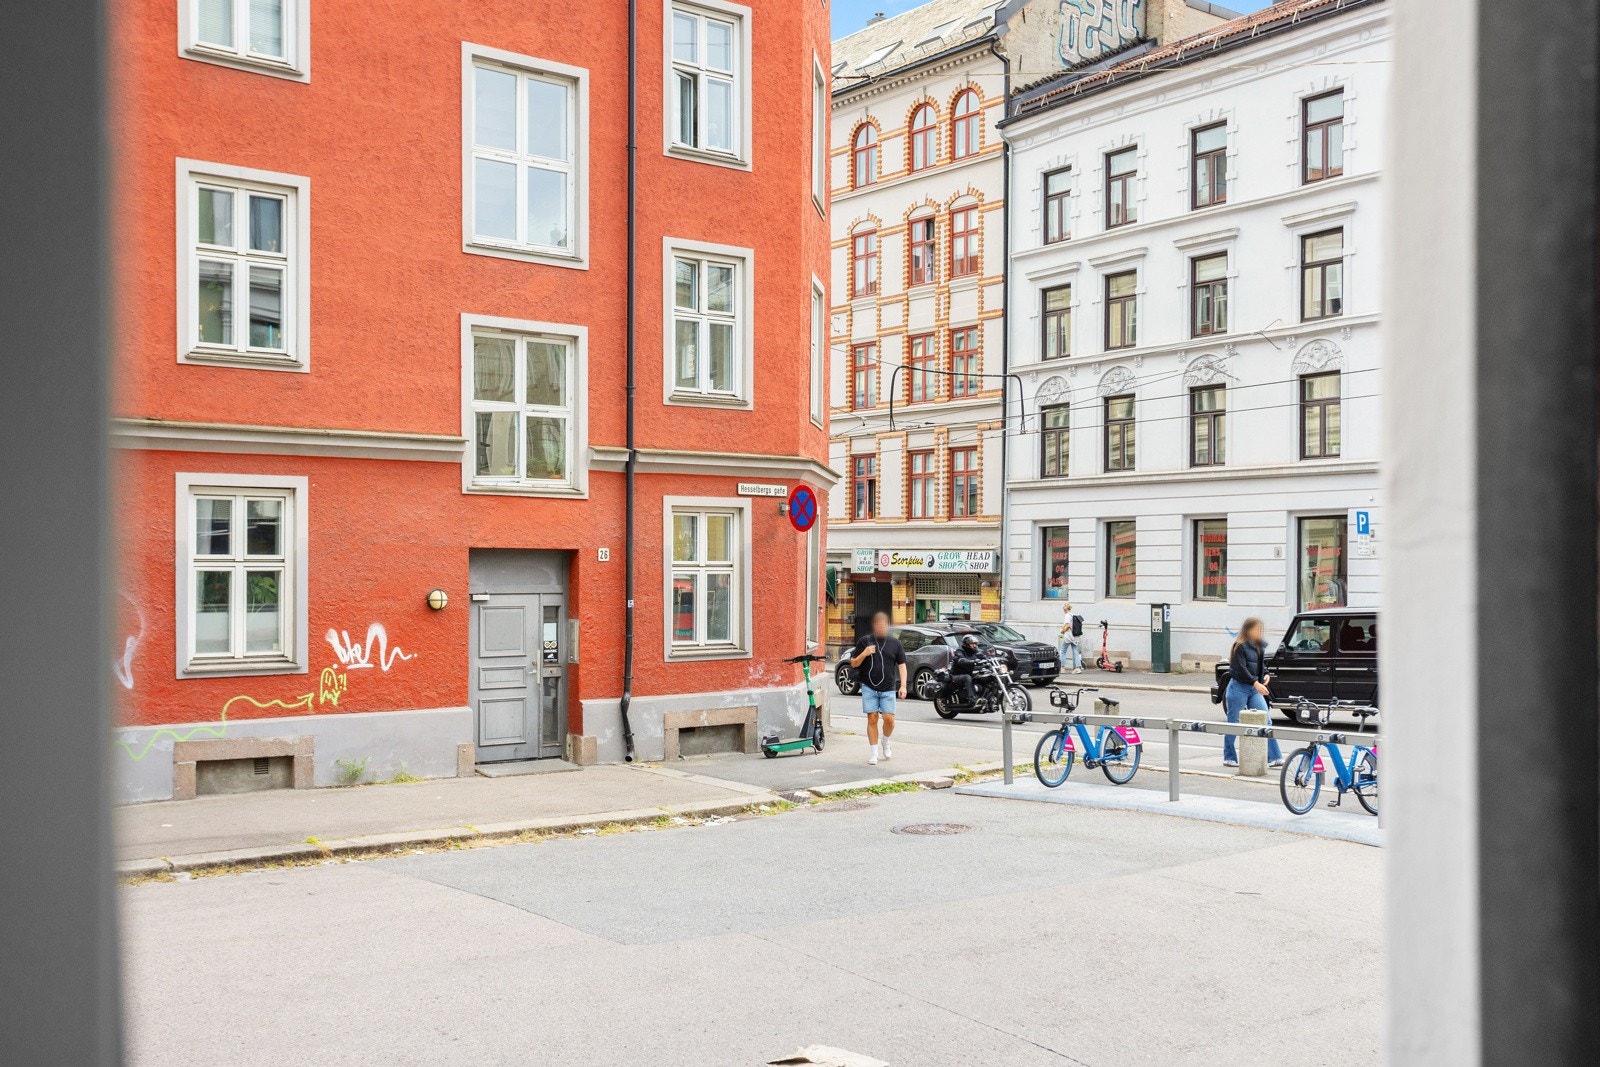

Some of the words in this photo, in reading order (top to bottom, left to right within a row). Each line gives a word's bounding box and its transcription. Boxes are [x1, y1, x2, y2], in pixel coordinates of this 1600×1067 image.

[740, 484, 771, 495] Hesselbergs
[774, 487, 786, 496] gate
[1359, 514, 1366, 531] P
[599, 550, 608, 560] 26
[891, 552, 925, 568] Scorpius
[937, 551, 961, 560] GROW
[966, 552, 990, 560] HEAD
[969, 562, 989, 570] SHOP
